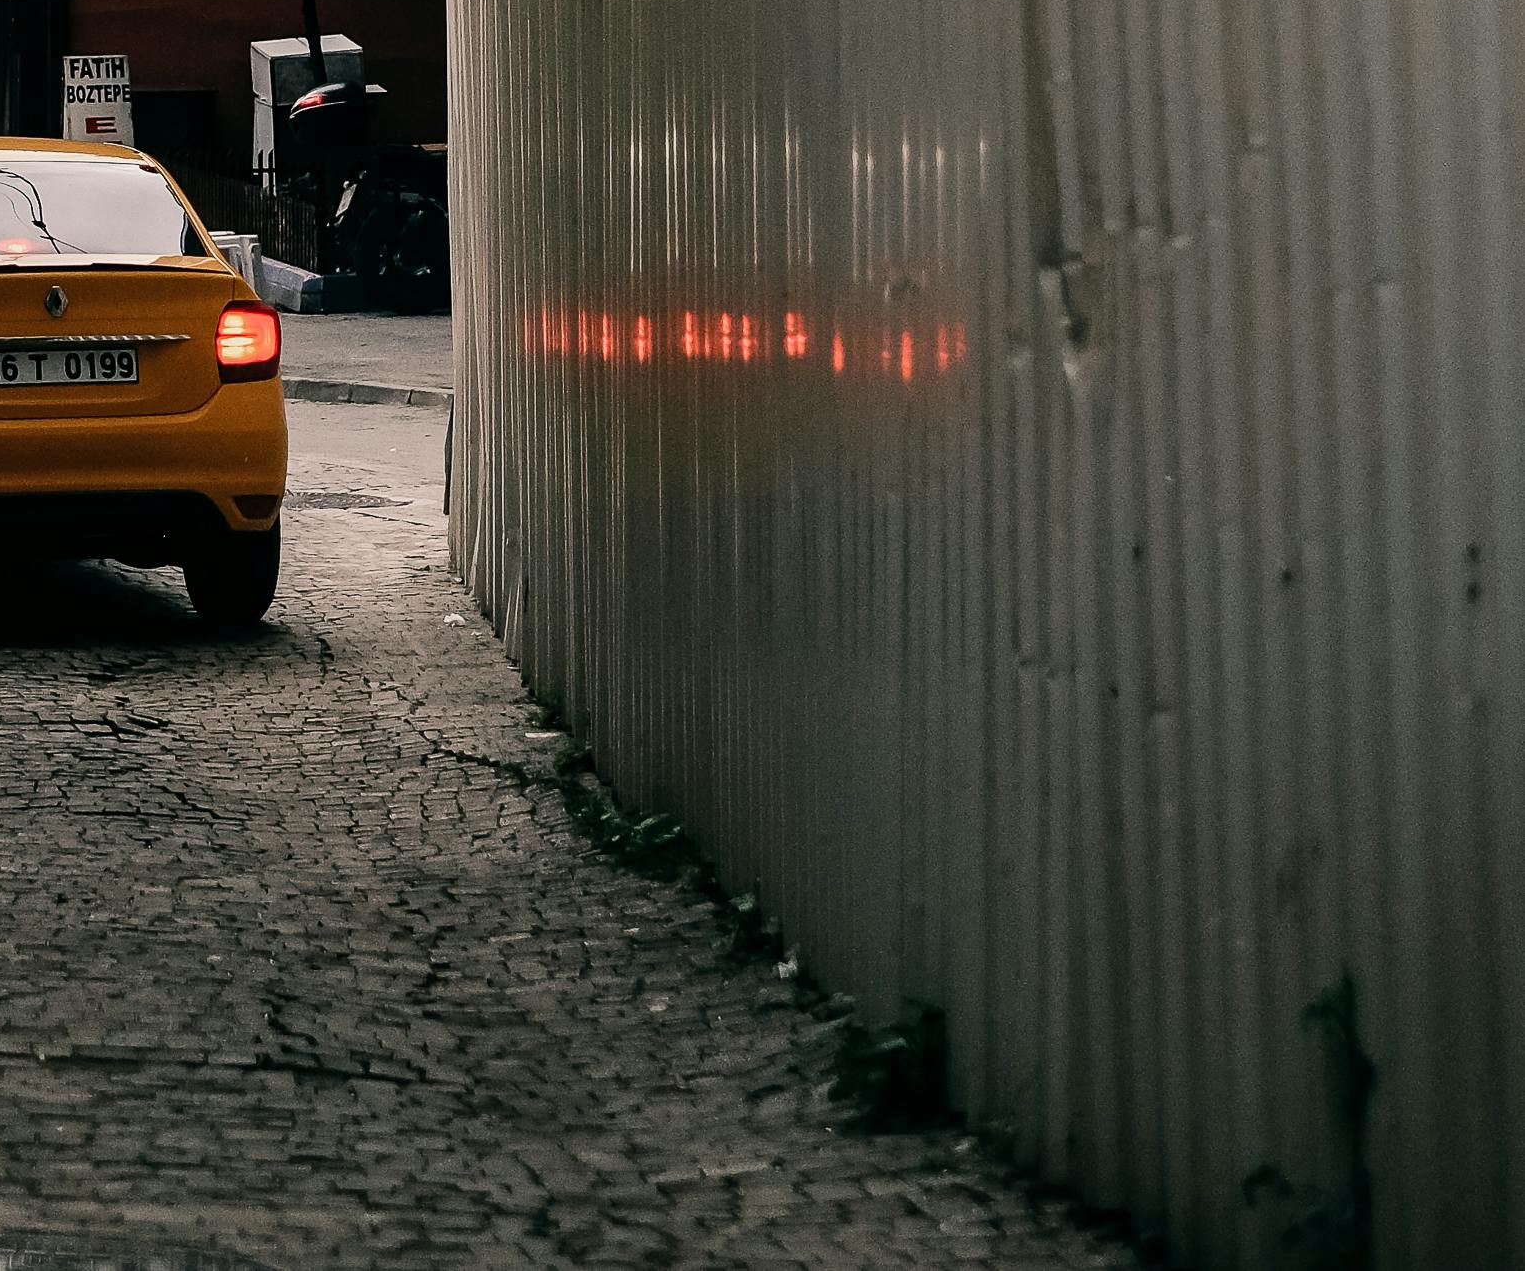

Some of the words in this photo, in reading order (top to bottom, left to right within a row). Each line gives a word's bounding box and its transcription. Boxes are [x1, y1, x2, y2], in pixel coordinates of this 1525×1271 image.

[67, 85, 131, 104] BOZTEPE
[28, 354, 48, 380] T
[64, 352, 135, 379] 0199
